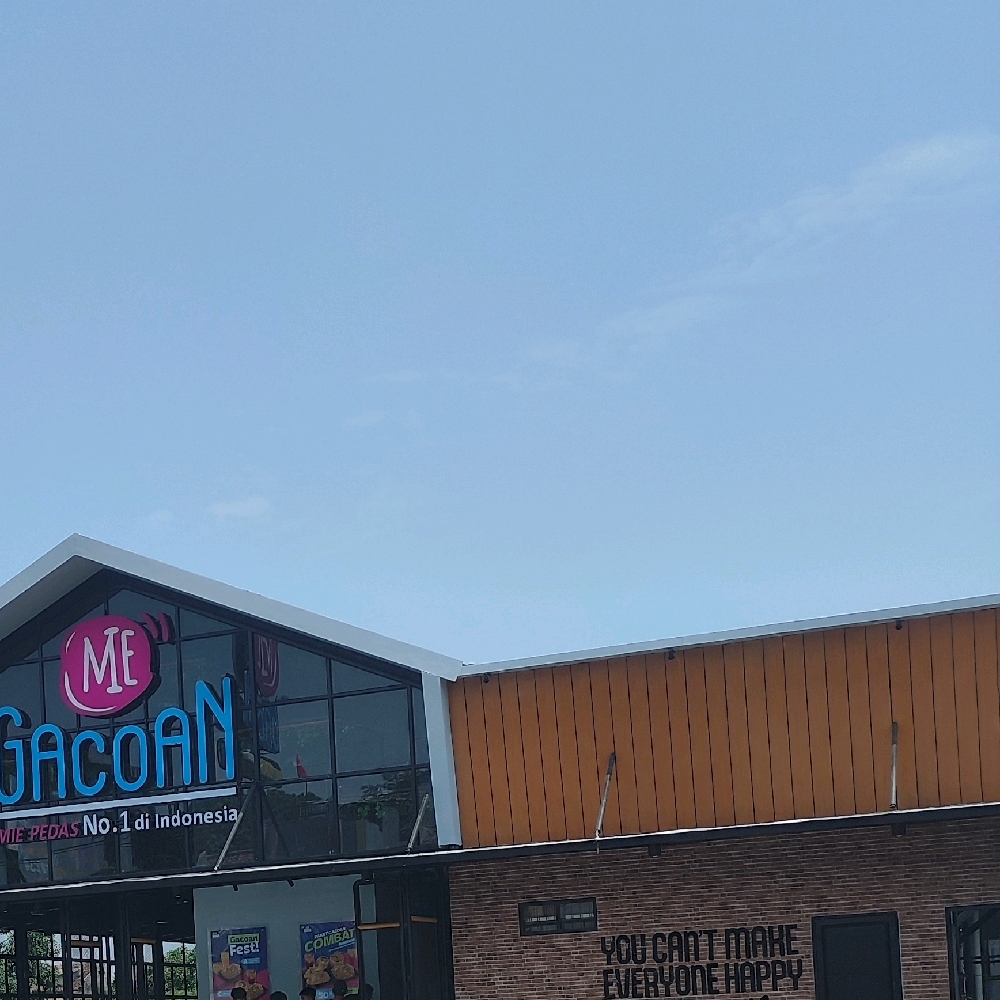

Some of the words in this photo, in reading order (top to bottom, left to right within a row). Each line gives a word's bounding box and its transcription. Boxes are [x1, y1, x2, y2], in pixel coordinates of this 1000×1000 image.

[28, 822, 80, 843] PEDAS
[135, 813, 150, 830] di
[155, 806, 238, 829] Indonesia
[229, 942, 260, 957] Fest!
[305, 928, 355, 952] COMBAT
[601, 934, 647, 965] YOU
[652, 929, 718, 963] CAN'T
[724, 923, 799, 960] MAKE
[603, 963, 720, 999] EVERYONE
[725, 959, 803, 994] HAPPY
